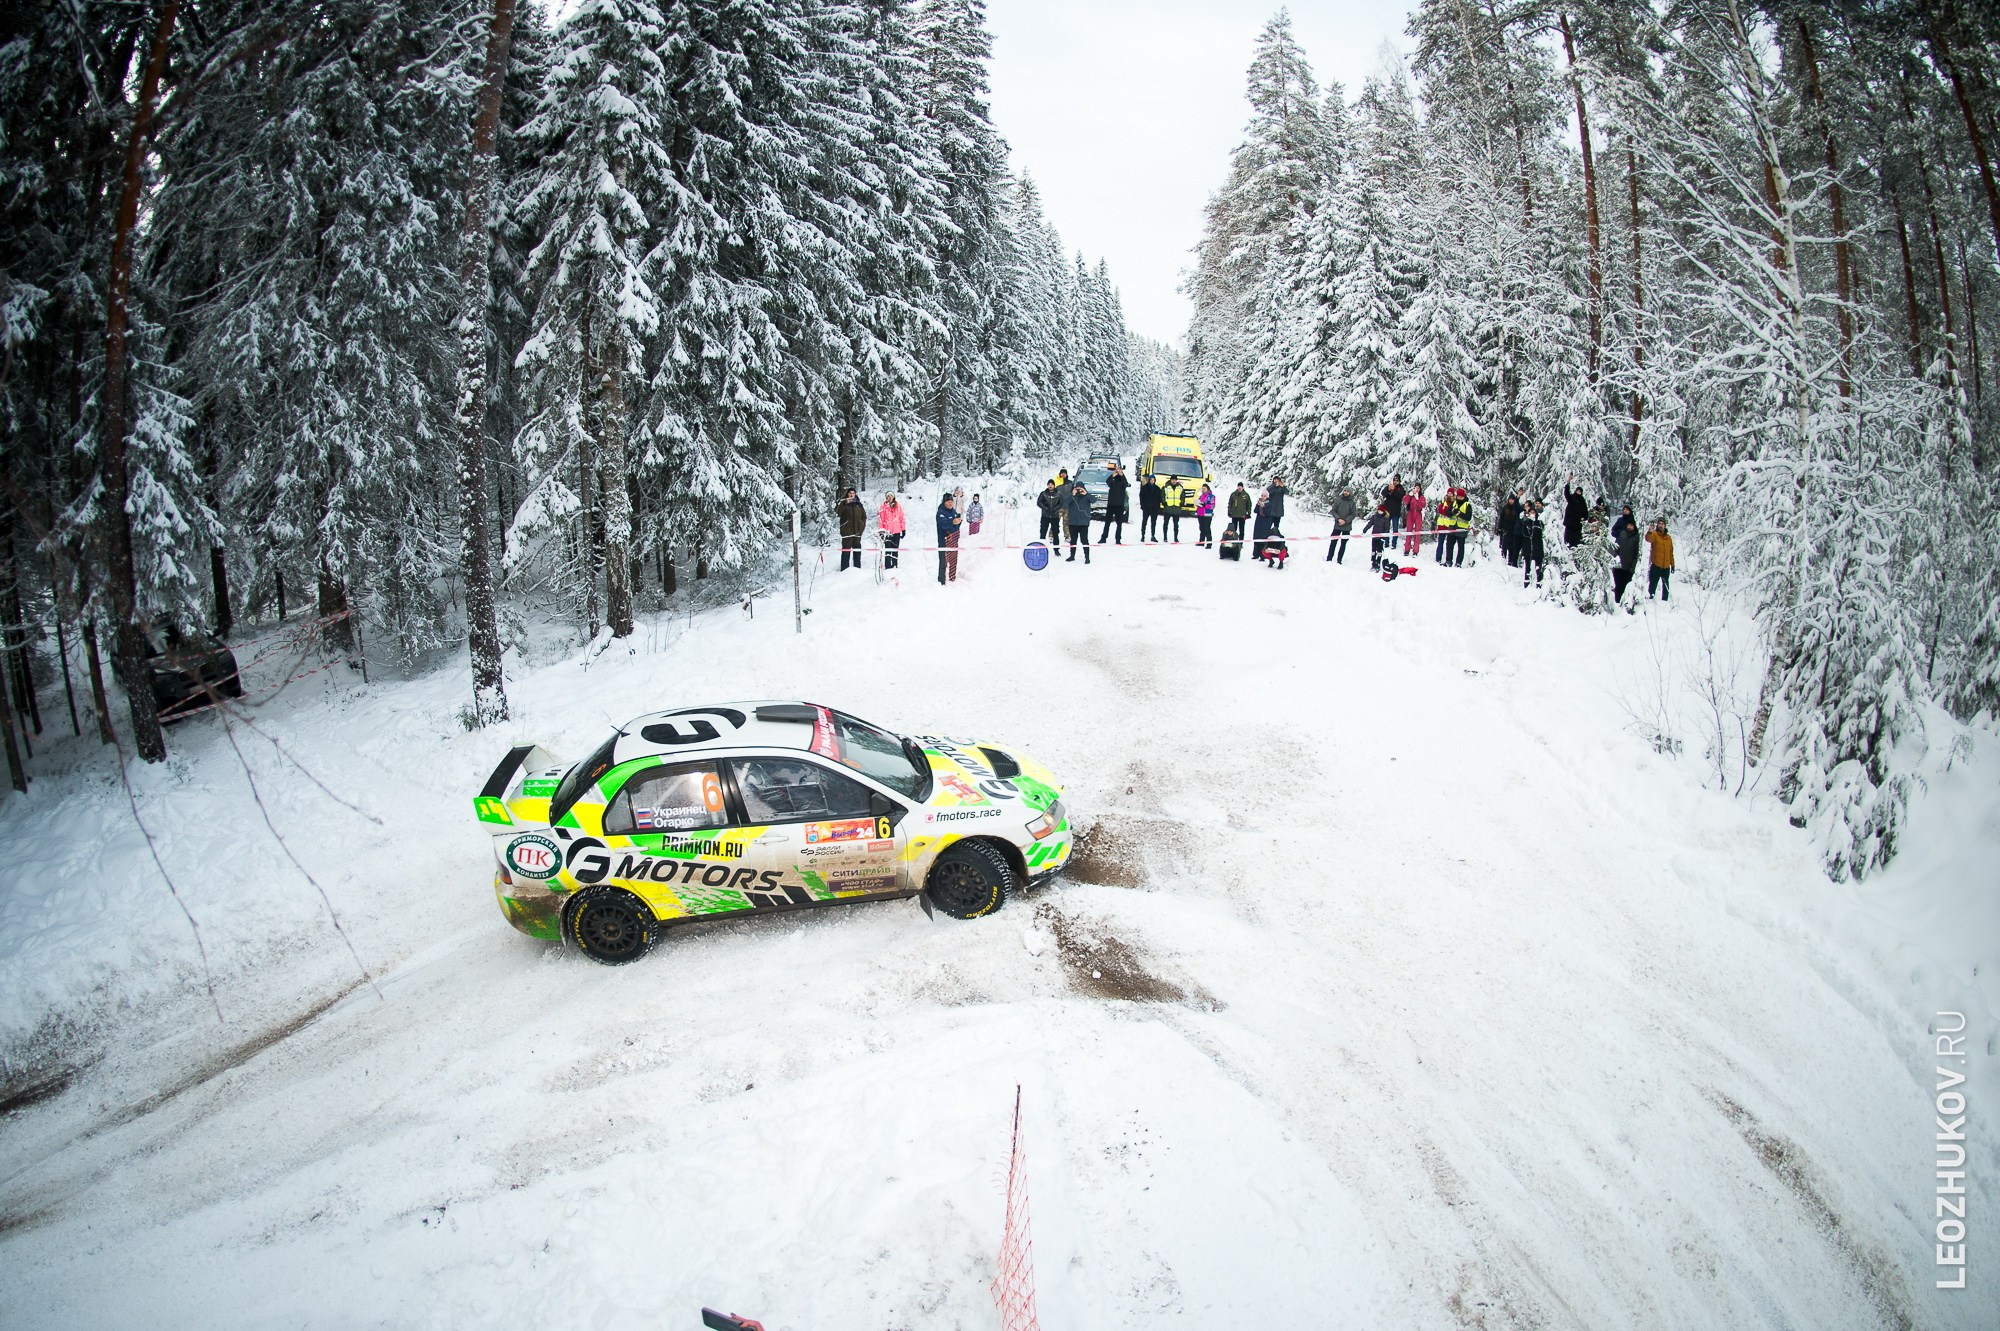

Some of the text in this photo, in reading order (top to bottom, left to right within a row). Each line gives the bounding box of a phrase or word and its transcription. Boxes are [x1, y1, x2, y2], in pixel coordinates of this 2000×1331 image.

[915, 735, 994, 777] MOTORS
[702, 772, 723, 812] 6
[652, 805, 708, 817] Украинец
[936, 808, 1002, 822] fmotors_race
[654, 817, 695, 829] Огарко
[878, 817, 891, 838] 6
[856, 827, 874, 838] 24
[513, 836, 558, 853] ПРИМОРСКИЙ
[662, 835, 743, 858] PRIMKON.RU
[516, 847, 551, 867] ПК
[614, 855, 784, 892] MOTORS
[832, 866, 891, 877] СИТИДРАЙВ
